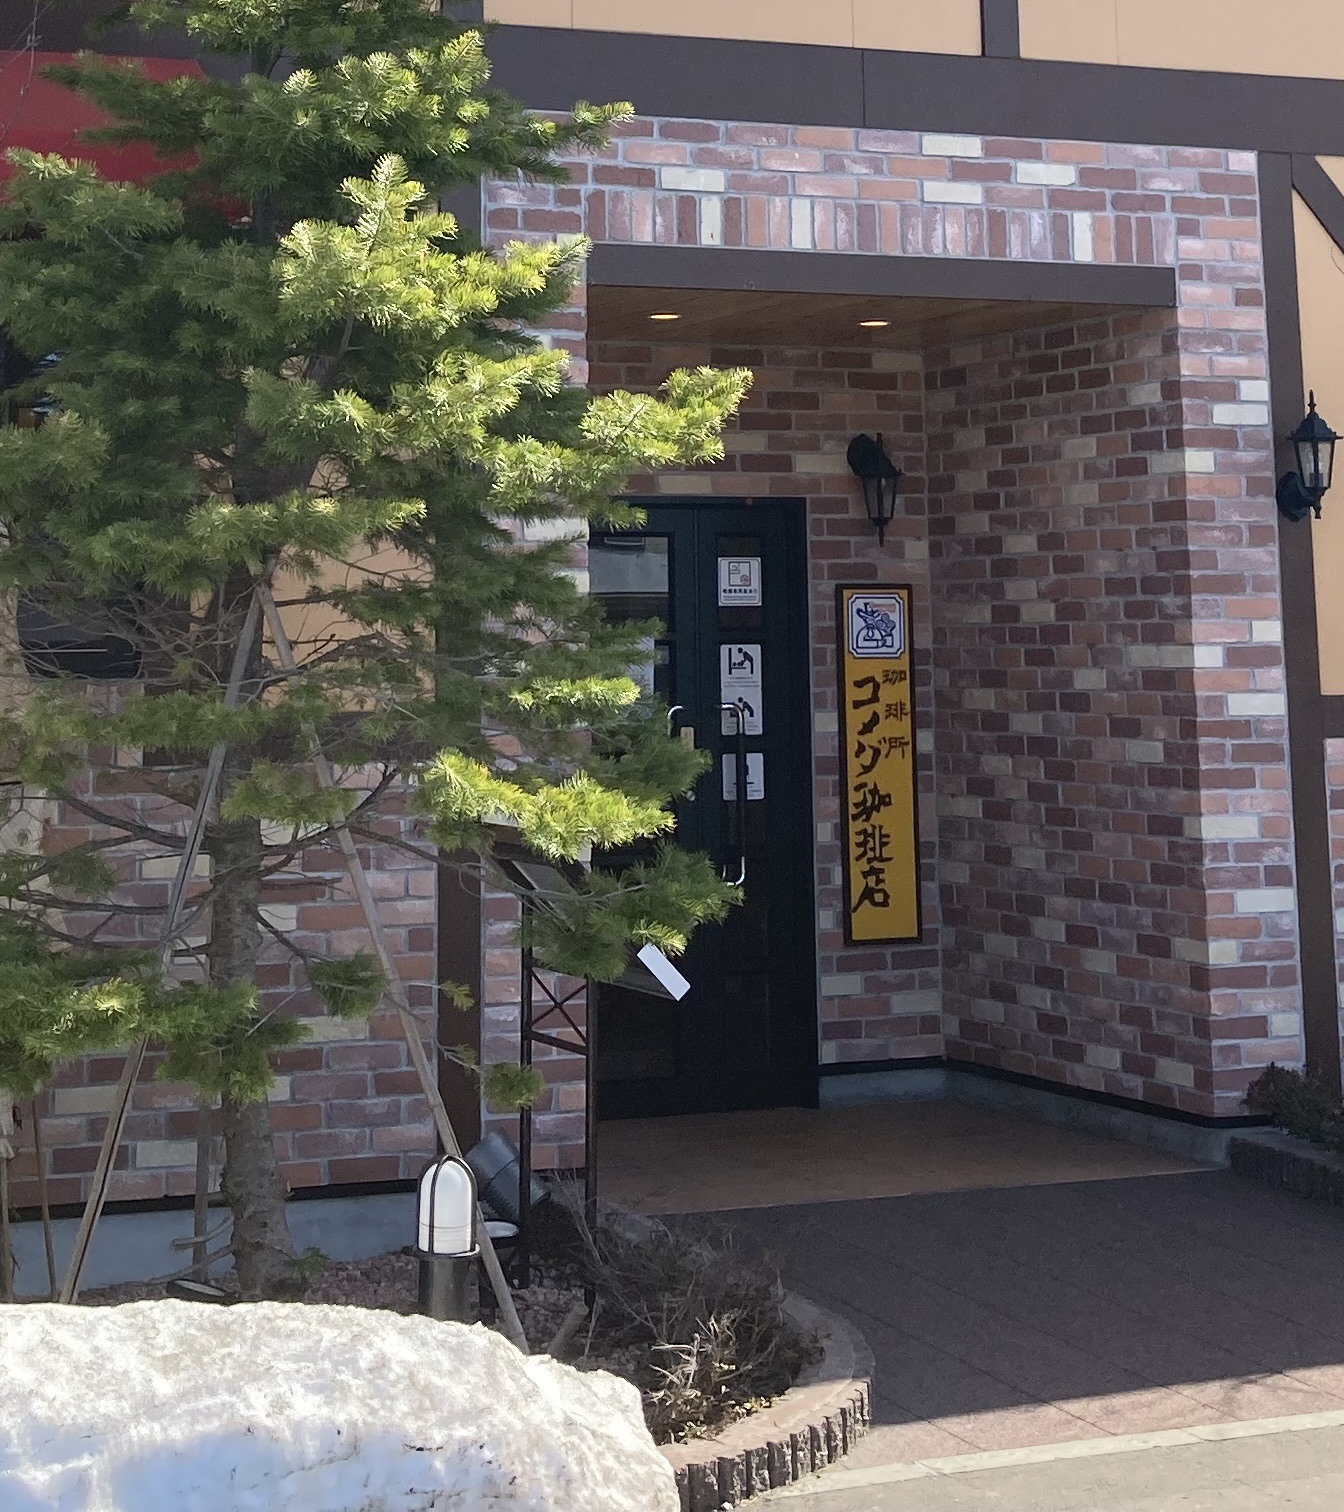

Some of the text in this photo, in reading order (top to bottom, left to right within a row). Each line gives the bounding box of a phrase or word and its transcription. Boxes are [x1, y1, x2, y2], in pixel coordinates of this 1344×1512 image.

[851, 675, 894, 913] コメダ珈琲店
[881, 669, 910, 759] 珈琲所
